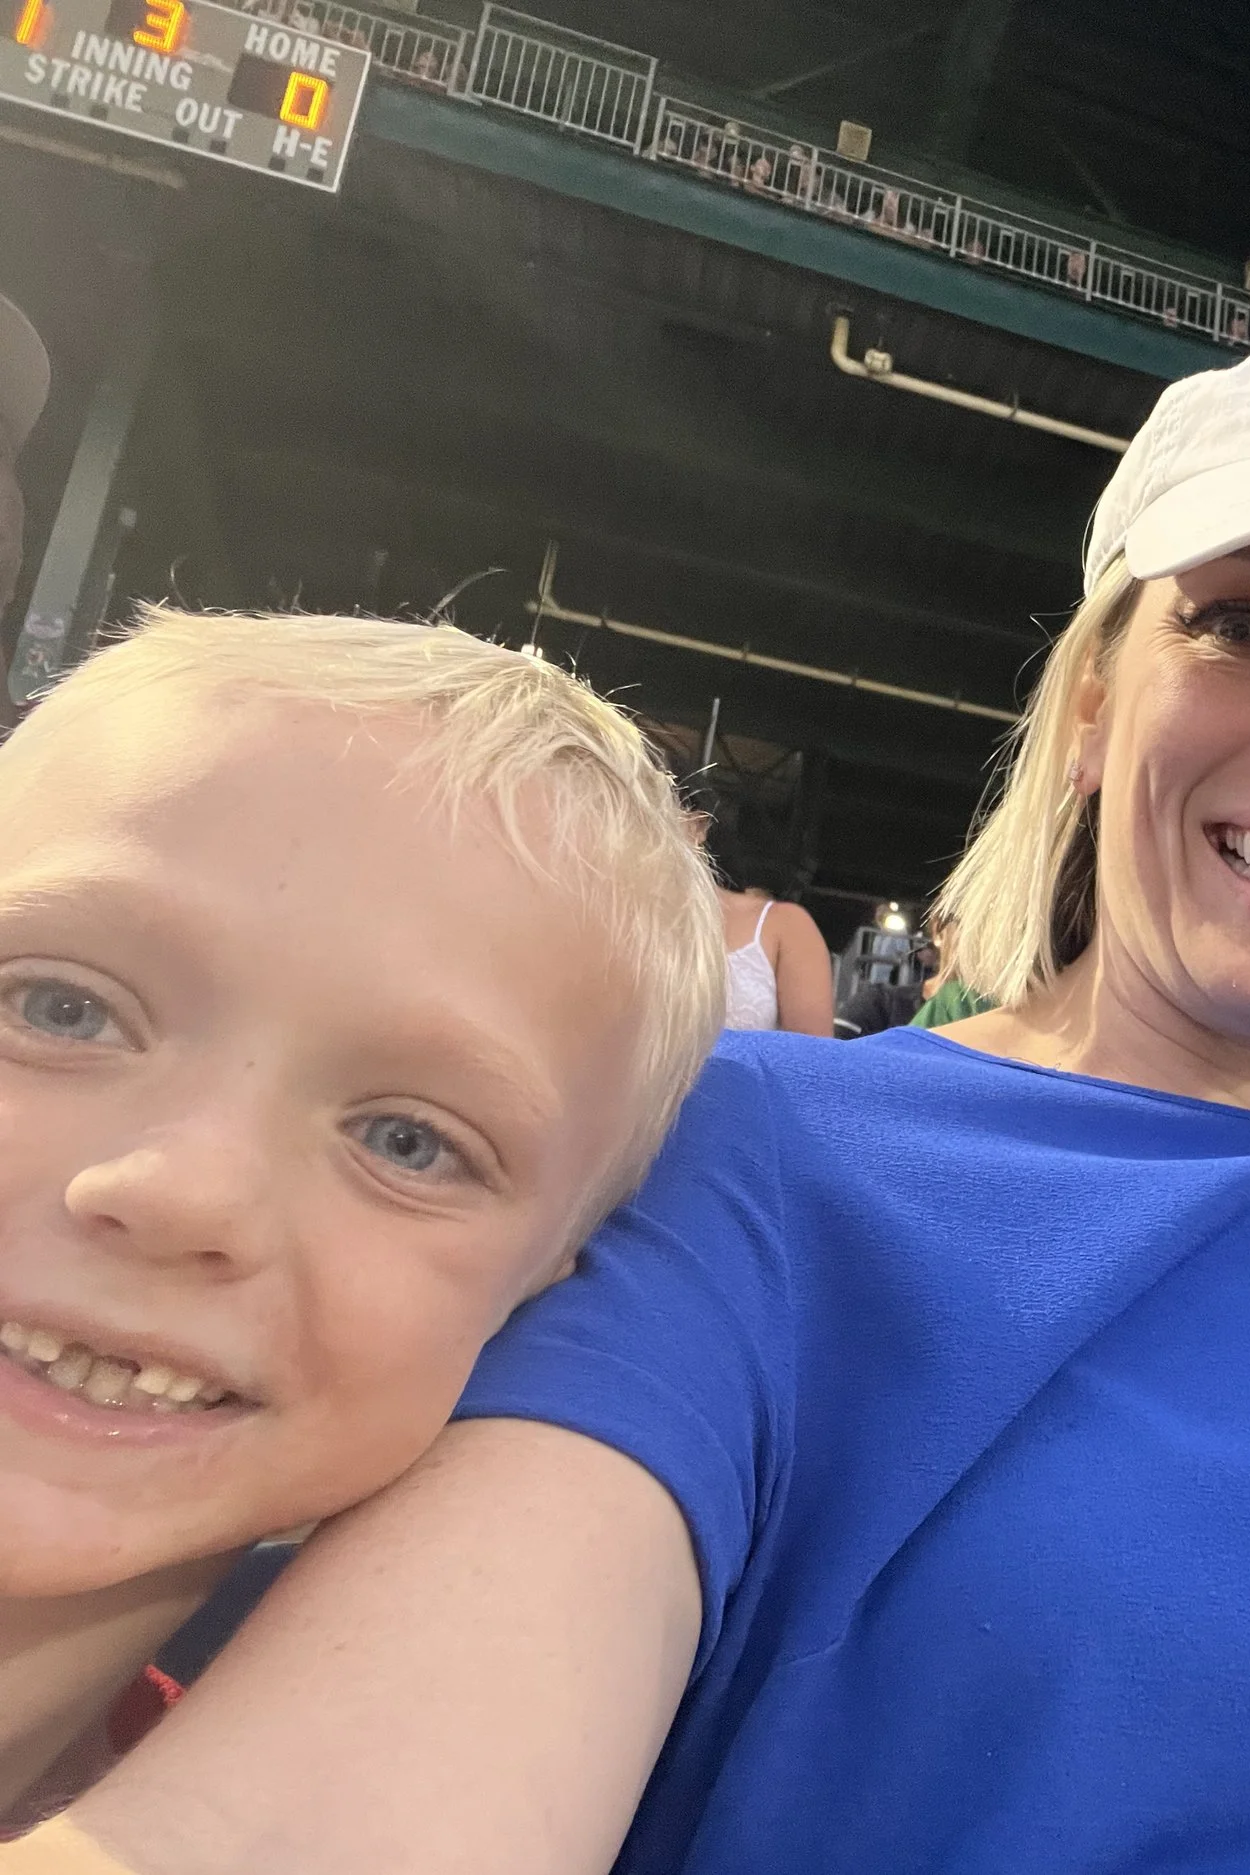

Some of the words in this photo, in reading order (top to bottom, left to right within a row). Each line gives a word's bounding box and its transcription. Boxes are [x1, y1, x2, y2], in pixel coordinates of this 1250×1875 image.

[133, 0, 184, 51] 3
[244, 23, 340, 78] HOME
[71, 30, 193, 91] INNING
[24, 53, 148, 114] STRIKE
[175, 98, 243, 139] OUT
[279, 71, 328, 130] 0
[272, 125, 333, 168] H-E
